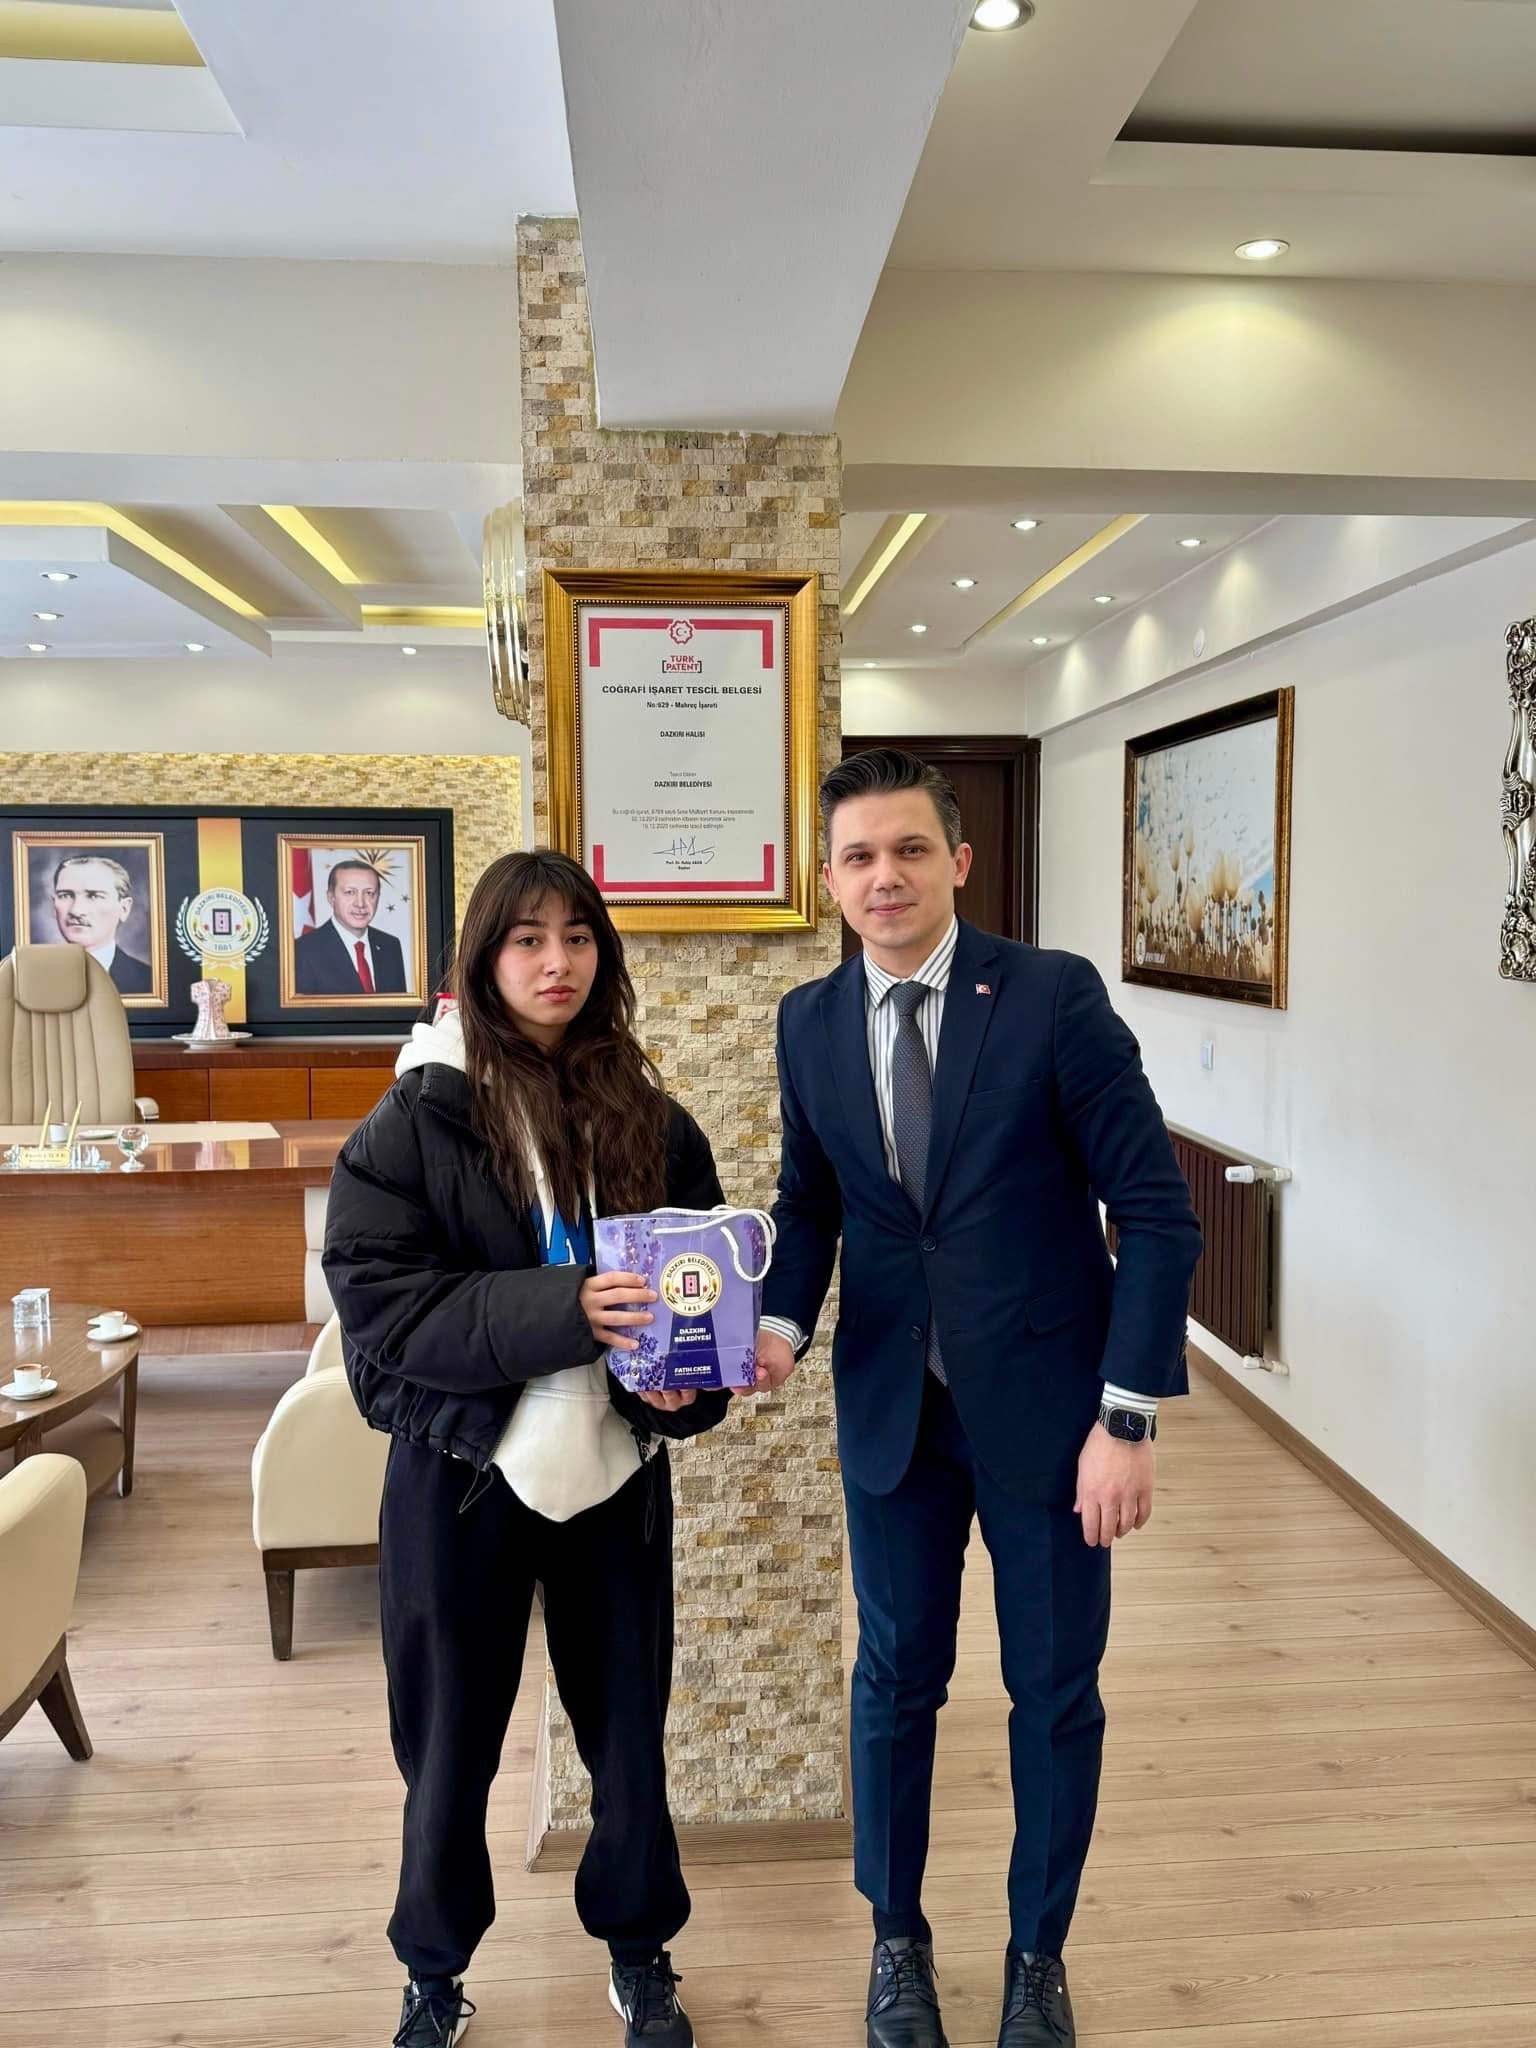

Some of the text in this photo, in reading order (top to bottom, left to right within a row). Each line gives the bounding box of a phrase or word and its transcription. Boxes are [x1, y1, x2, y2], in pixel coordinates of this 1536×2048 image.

[666, 663, 699, 671] PATENT
[602, 684, 762, 696] COĞRAFİ İŞARET TESCİL BELGESİ
[654, 780, 678, 788] DAZKIRI
[674, 1334, 711, 1342] BELEDİYESİ
